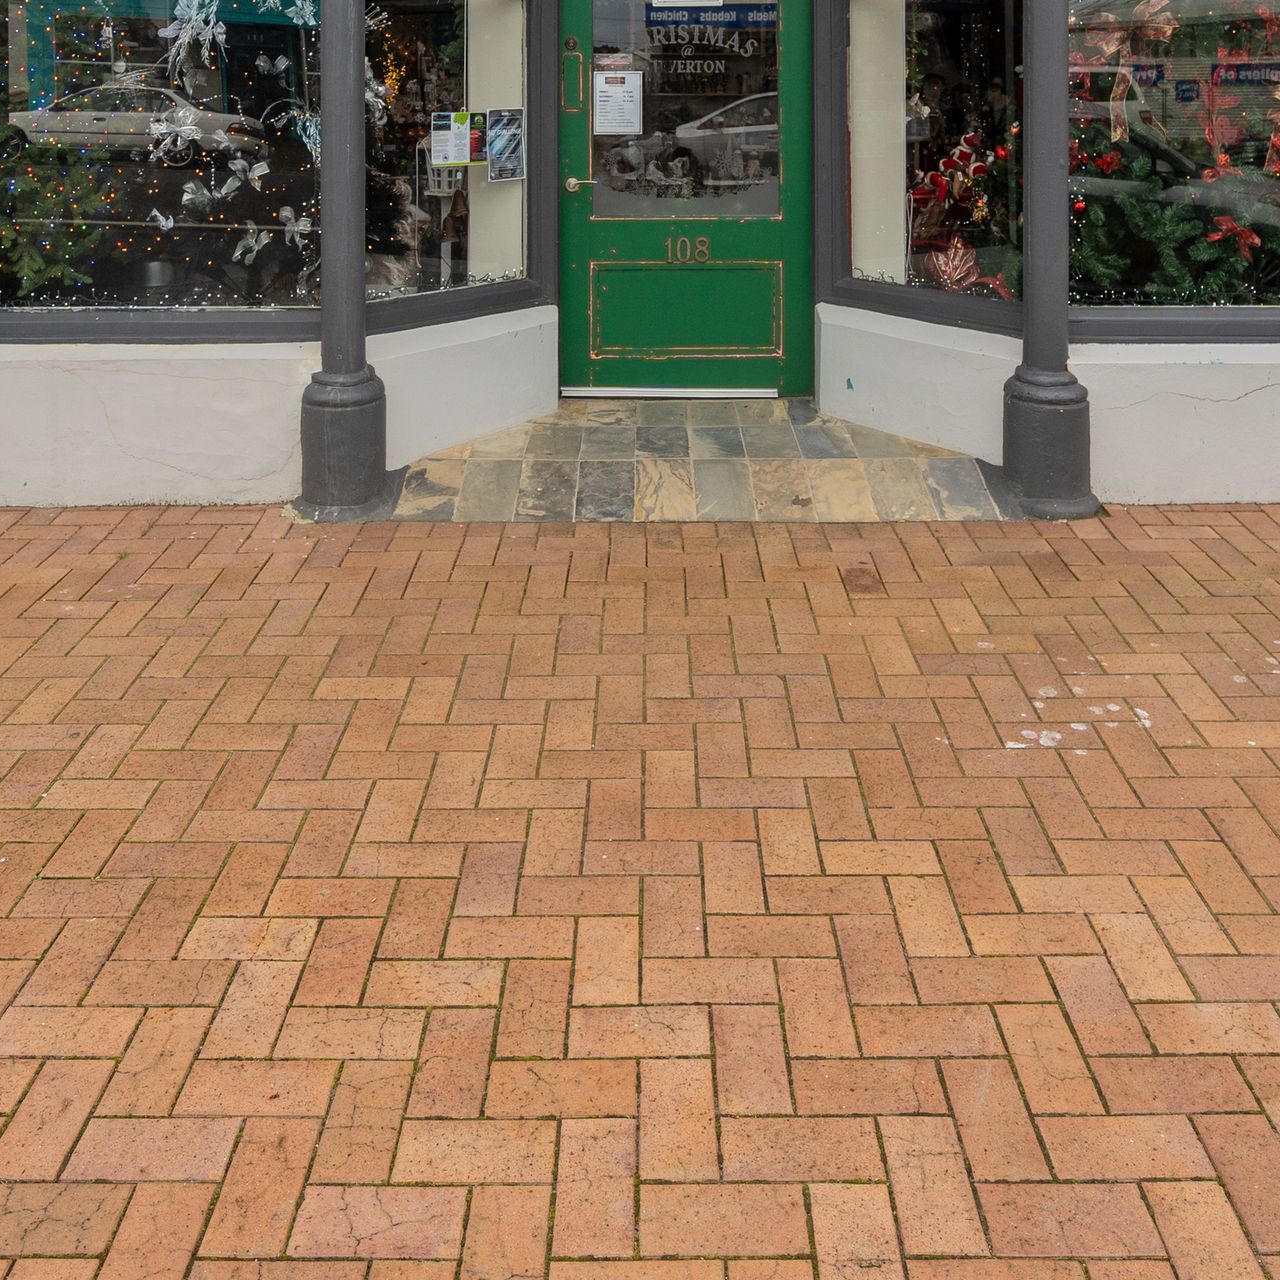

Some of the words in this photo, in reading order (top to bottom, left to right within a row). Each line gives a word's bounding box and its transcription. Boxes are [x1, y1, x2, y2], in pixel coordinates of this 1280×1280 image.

[643, 24, 758, 58] RISTMAS
[681, 44, 695, 58] @
[664, 236, 709, 262] 108
